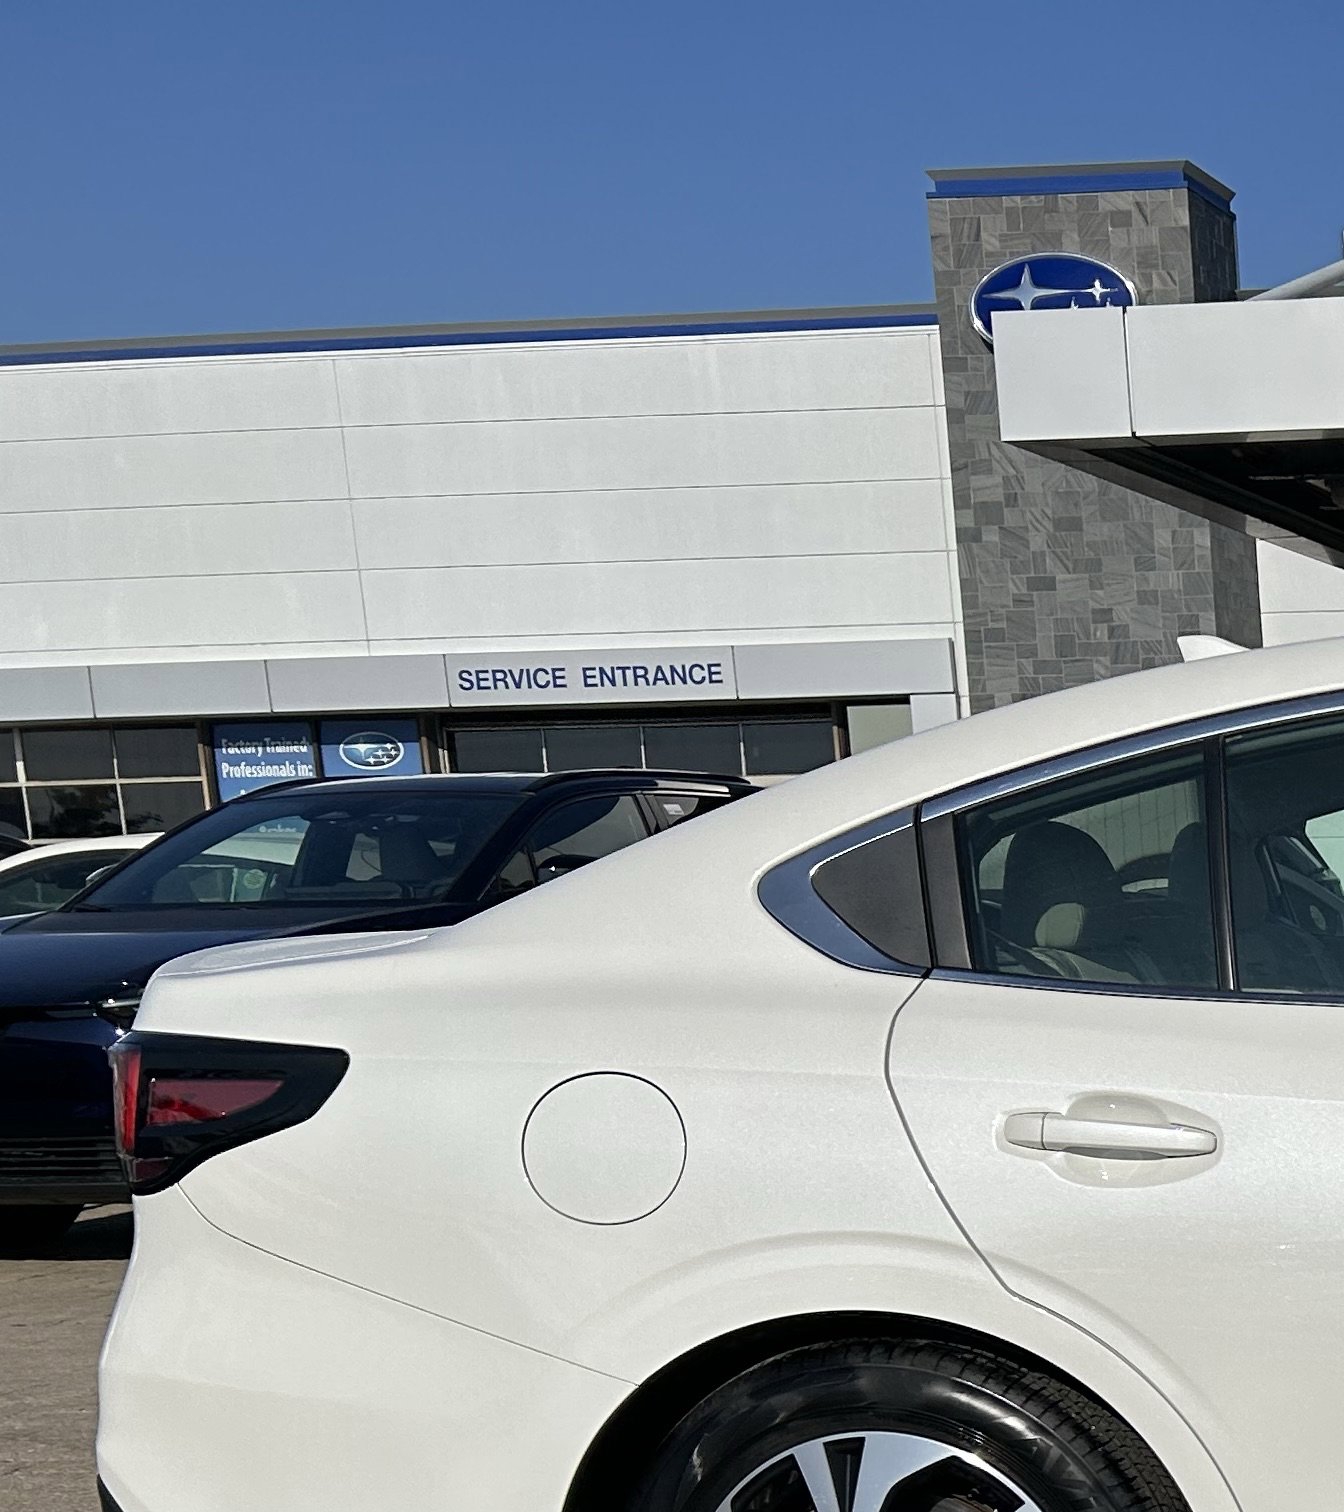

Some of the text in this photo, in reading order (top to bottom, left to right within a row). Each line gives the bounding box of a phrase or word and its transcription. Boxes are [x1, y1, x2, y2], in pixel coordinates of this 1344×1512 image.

[458, 663, 724, 691] SERVICE ENTRANCE
[221, 735, 308, 757] Factory Trained
[221, 760, 314, 779] Professionals in:
